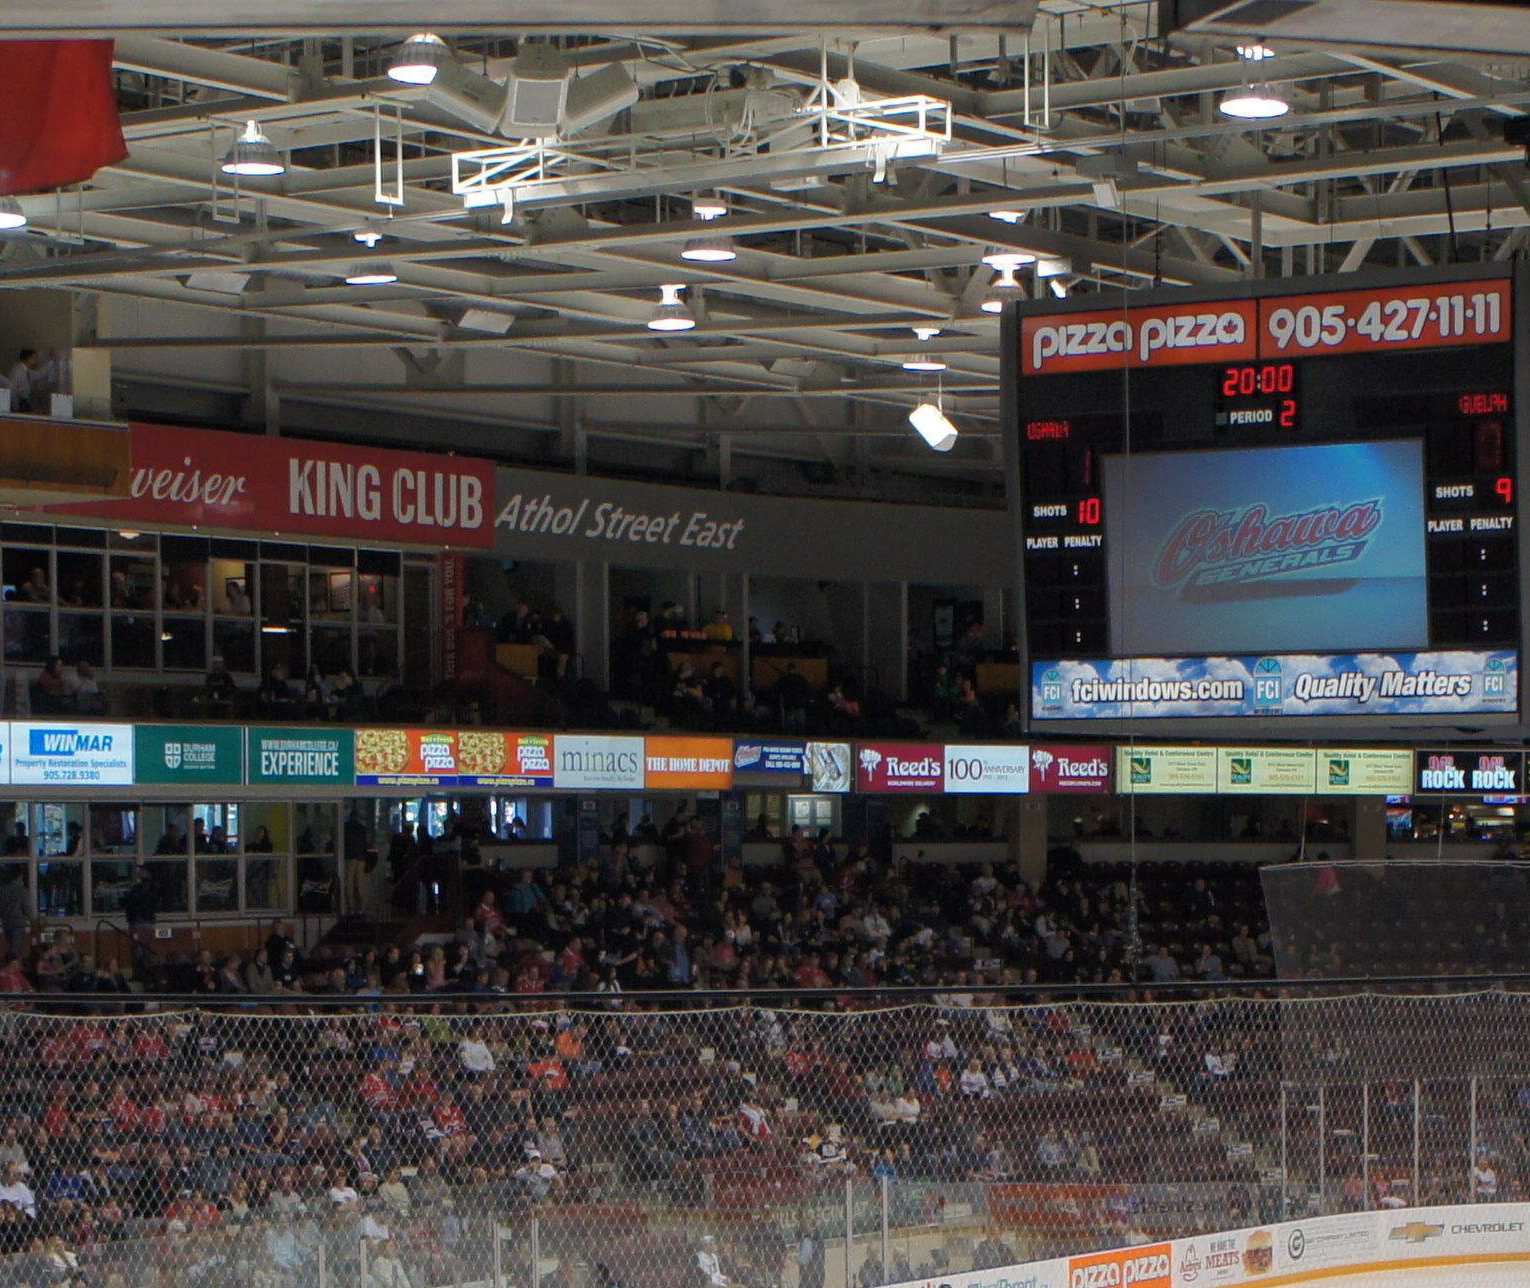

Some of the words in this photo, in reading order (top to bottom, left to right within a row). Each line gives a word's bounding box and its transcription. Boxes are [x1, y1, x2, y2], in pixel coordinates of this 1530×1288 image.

[1033, 321, 1133, 369] pizza
[1139, 312, 1245, 361] pizza
[1223, 364, 1294, 396] 20:00
[1229, 408, 1274, 424] PERIOD
[289, 457, 381, 521] KING
[392, 468, 483, 529] CLUB
[1435, 486, 1474, 499] SHOTS
[1032, 505, 1067, 518] SHOTS
[495, 494, 589, 536] Athol
[585, 503, 680, 544] Street
[679, 512, 746, 550] East
[1428, 518, 1464, 533] PLAYER
[1470, 516, 1513, 531] PENALTY
[1026, 536, 1059, 551] PLAYER
[1064, 534, 1102, 549] PENALTY
[1072, 677, 1245, 704] fciwindows.com
[1295, 673, 1375, 704] Quality
[1380, 672, 1472, 698] Matters
[43, 732, 114, 753] WINMAR
[183, 743, 216, 753] DURHAM
[183, 753, 216, 763] COLLEGE
[420, 744, 450, 761] pizza
[561, 745, 638, 774] minacs
[15, 758, 46, 770] Property
[48, 759, 90, 770] Restoration
[91, 759, 127, 771] Specialists
[260, 752, 339, 777] EXPERIENCE
[646, 757, 665, 773] THE
[666, 757, 694, 773] HOME
[695, 757, 731, 773] DEPOT
[886, 757, 942, 777] Reed's
[946, 756, 983, 780] 100
[984, 764, 1026, 775] ANNIVERSARY
[1057, 758, 1108, 778] Reed's
[1421, 770, 1465, 789] ROCK
[1450, 1221, 1525, 1236] CHEVROLET
[1205, 1251, 1240, 1270] MEATS
